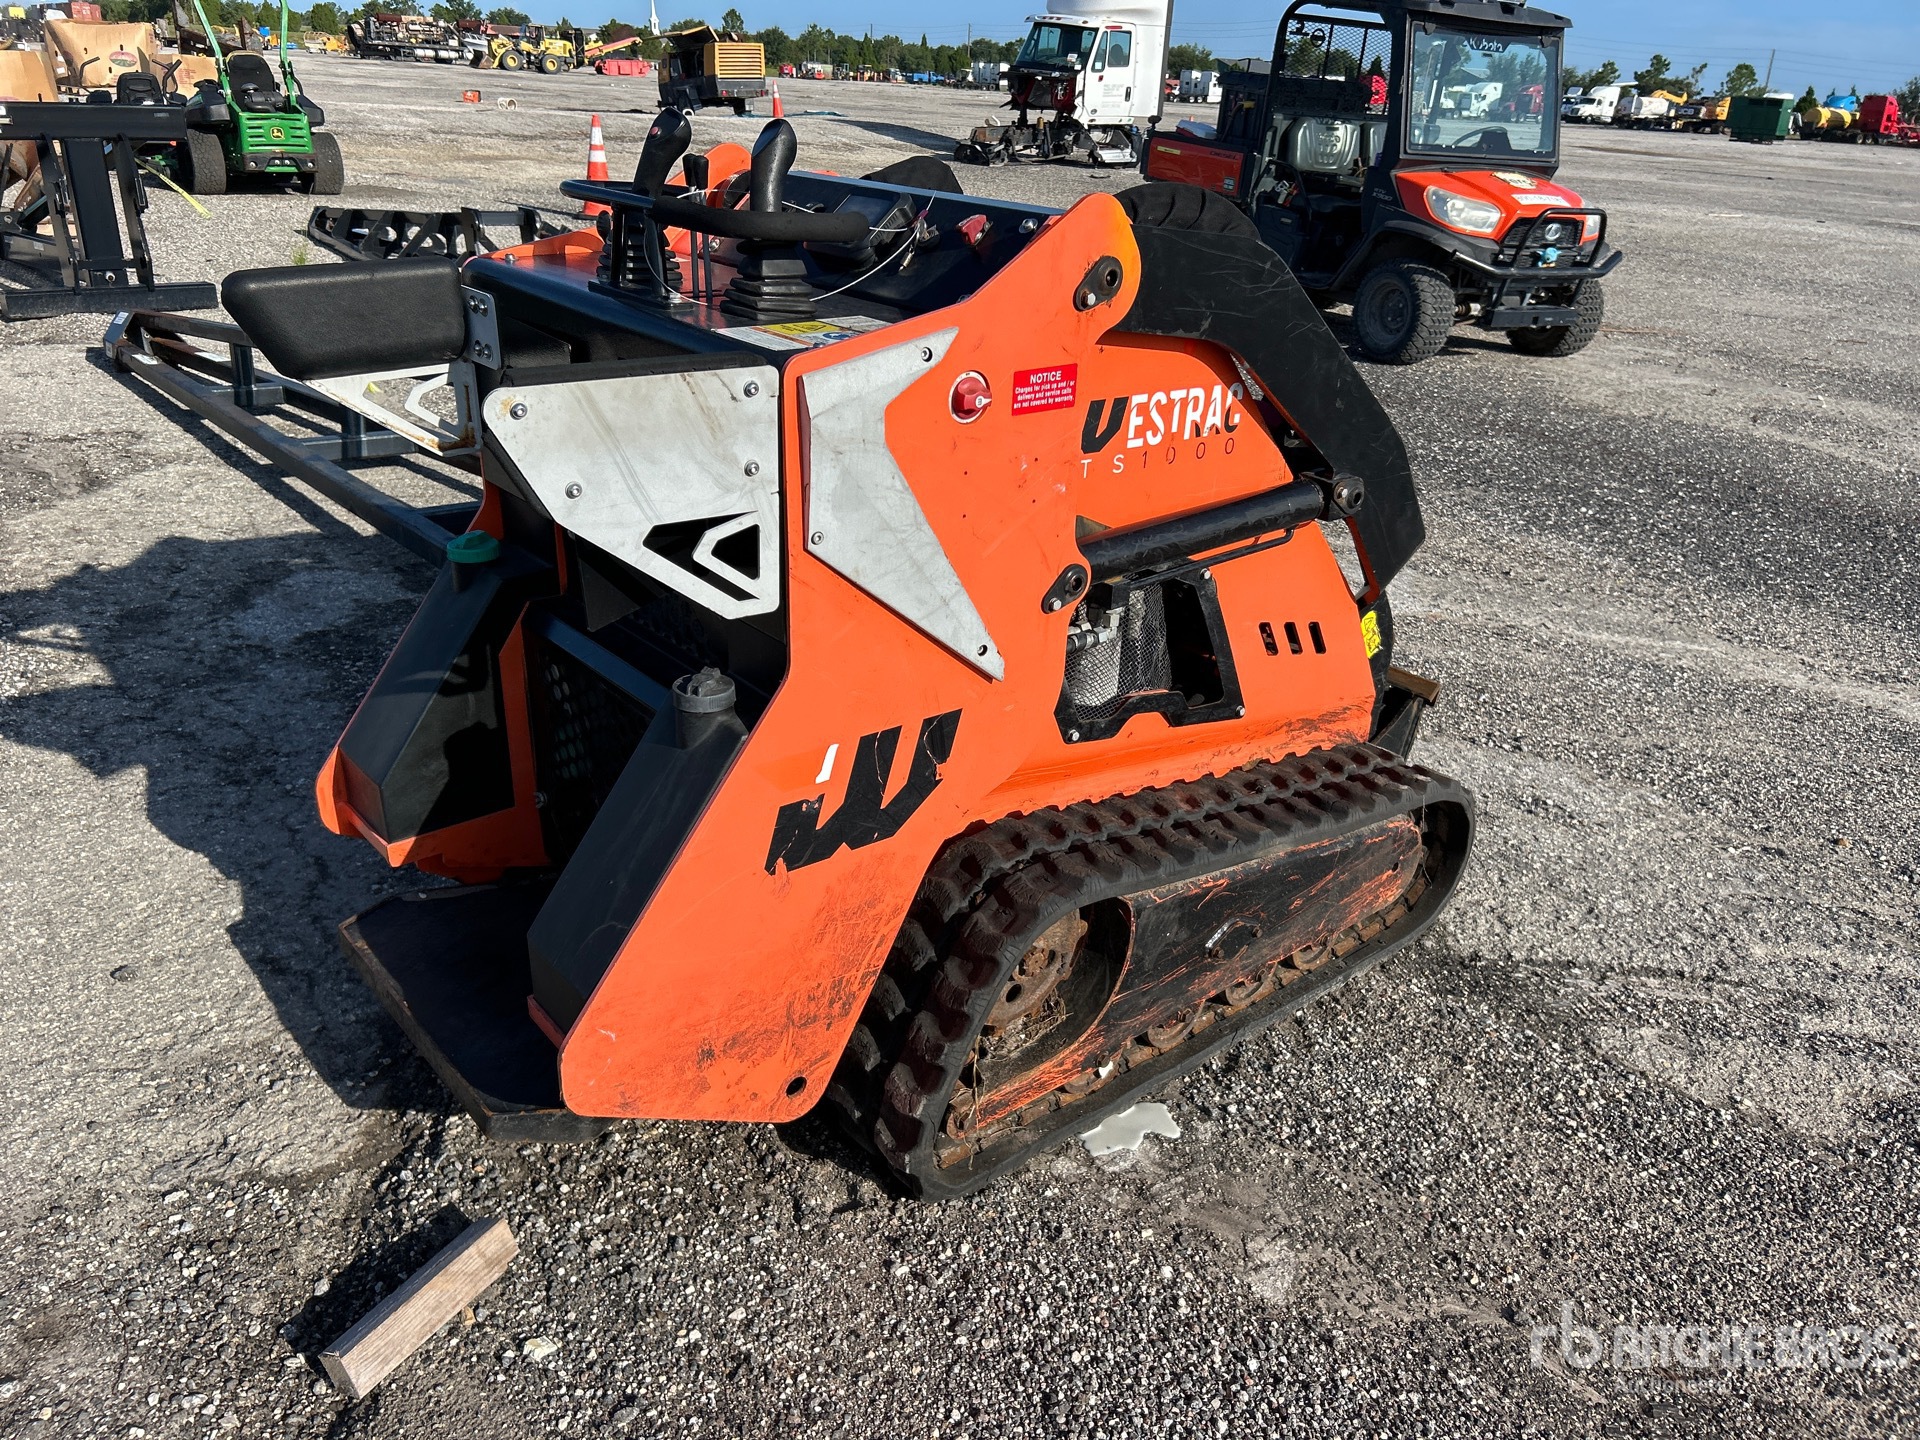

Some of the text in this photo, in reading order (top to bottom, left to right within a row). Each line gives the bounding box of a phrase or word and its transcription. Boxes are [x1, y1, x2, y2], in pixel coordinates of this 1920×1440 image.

[1030, 371, 1061, 384] NOTICE
[1015, 386, 1033, 394] Charges
[1041, 383, 1050, 391] pick
[1058, 380, 1066, 388] and
[1036, 391, 1044, 399] and
[1030, 398, 1047, 406] covered
[1048, 396, 1054, 405] by
